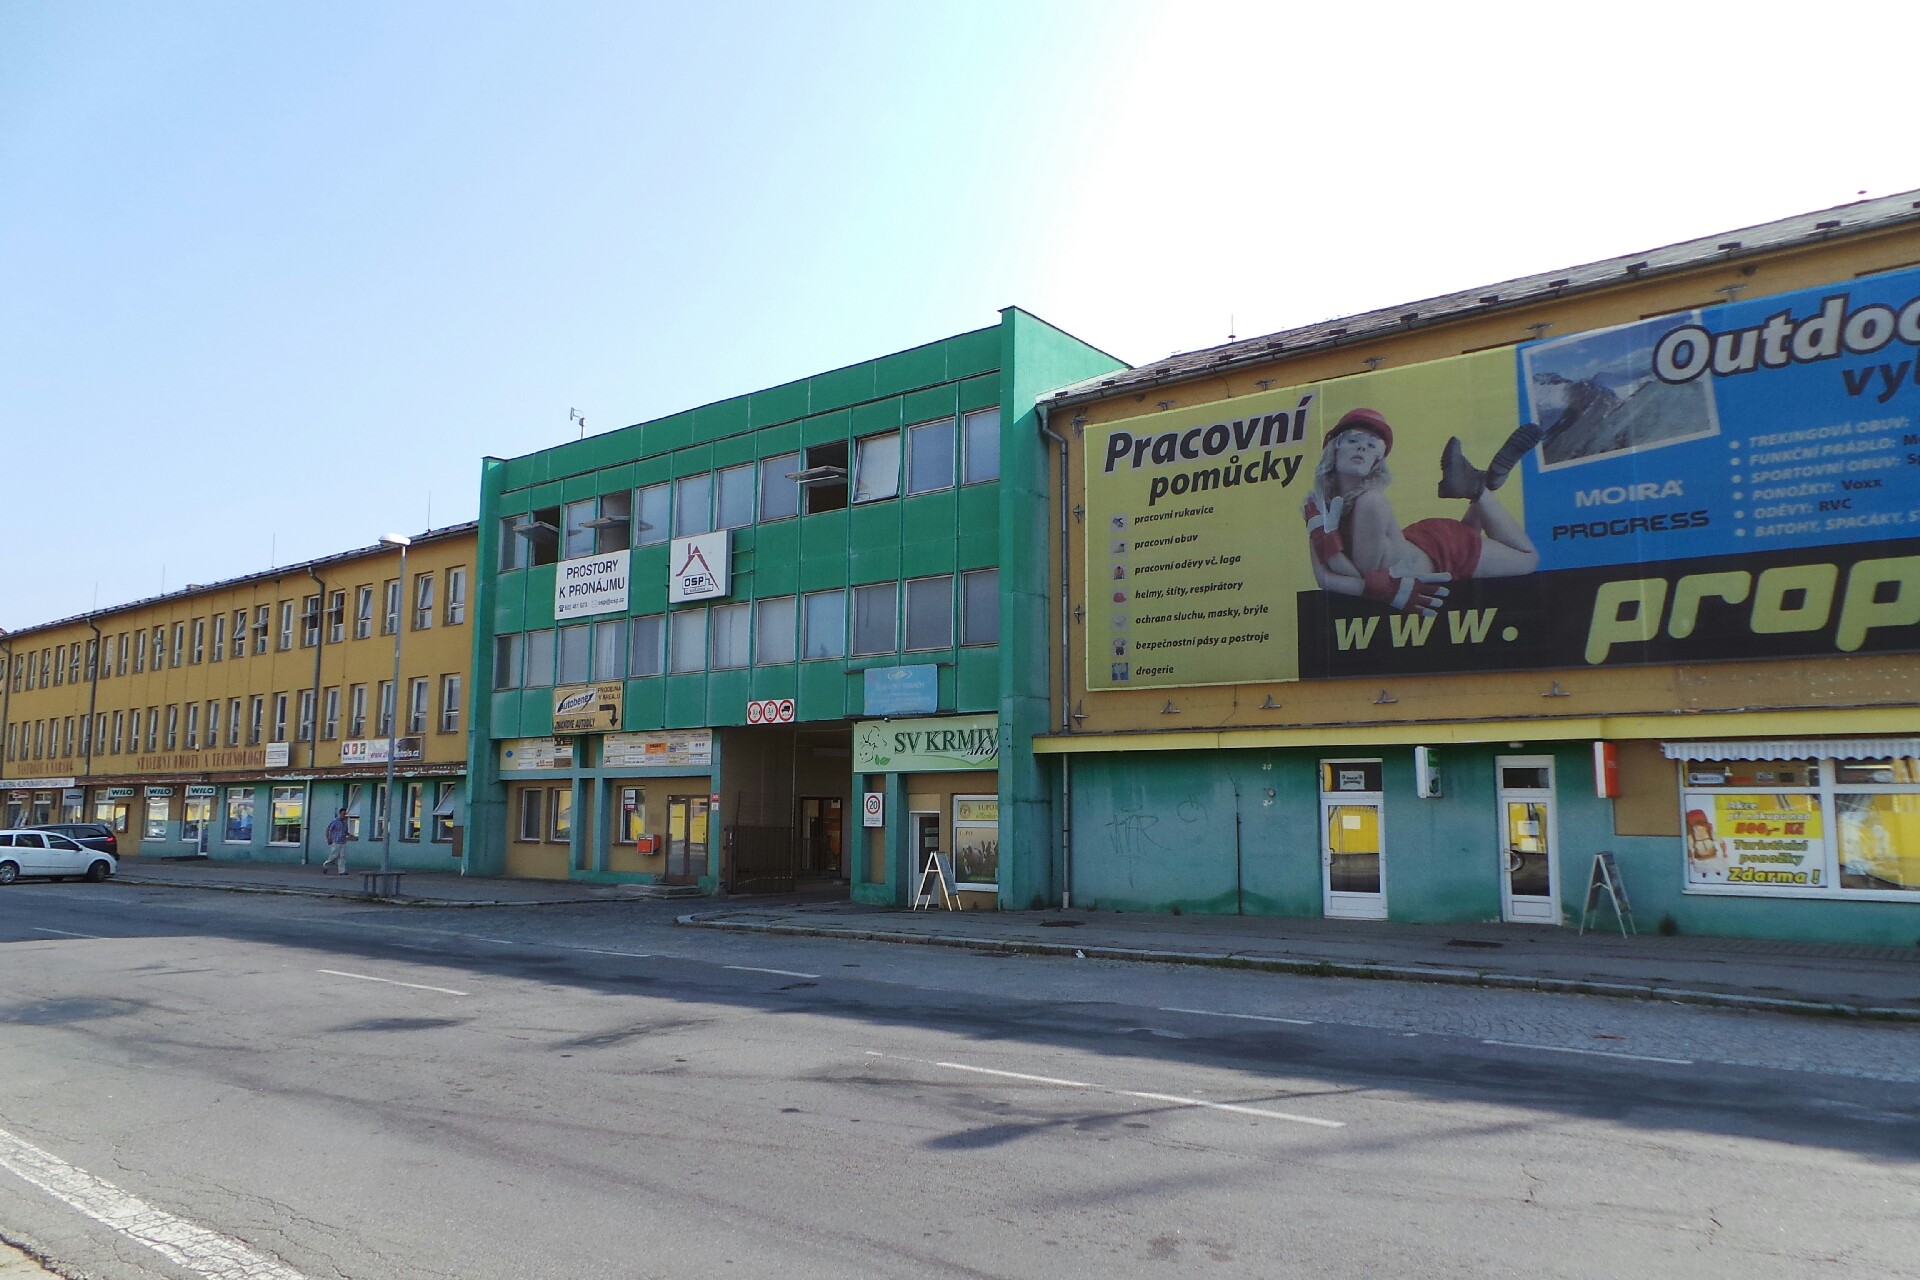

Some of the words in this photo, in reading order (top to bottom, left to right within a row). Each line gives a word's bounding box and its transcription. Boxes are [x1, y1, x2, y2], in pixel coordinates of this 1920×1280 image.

[1842, 354, 1920, 404] vy
[1104, 395, 1313, 473] Pracovní
[1148, 451, 1304, 506] pomůcky
[1751, 460, 1843, 483] SPORTOVNÍ
[1574, 479, 1684, 508] MOIRA
[1134, 510, 1173, 525] pracovní
[1174, 505, 1214, 519] rukavice
[1819, 498, 1852, 512] RVC
[1552, 509, 1711, 542] PROGRESS
[1134, 536, 1173, 550] pracovní
[1175, 534, 1199, 546] obuv
[566, 559, 619, 580] PROSTORY
[1134, 561, 1174, 575] pracovní
[1174, 558, 1203, 573] oděvy
[1205, 556, 1218, 566] vč.
[1220, 554, 1241, 568] loga
[559, 586, 566, 599] K
[569, 576, 625, 598] PRONÁJMU
[684, 576, 704, 587] OSP
[1135, 588, 1164, 600] helmy,
[1166, 585, 1189, 598] štíty,
[1190, 580, 1244, 595] respirátory
[1135, 613, 1172, 625] ochrana
[1173, 610, 1206, 621] sluchu,
[1208, 606, 1241, 619] masky,
[1243, 604, 1269, 617] brýle
[1135, 636, 1196, 651] bezpečnostní
[1197, 634, 1220, 648] pásy
[1221, 636, 1227, 644] a
[1228, 631, 1270, 646] postroje
[1135, 664, 1174, 678] drogerie
[894, 732, 922, 754] SV
[111, 788, 133, 796] WILO
[149, 787, 171, 796] WILO
[191, 786, 214, 795] WILO
[869, 800, 878, 810] 20
[1738, 851, 1804, 867] ponožky
[1727, 866, 1809, 884] Zdarma
[1811, 868, 1821, 885] !
